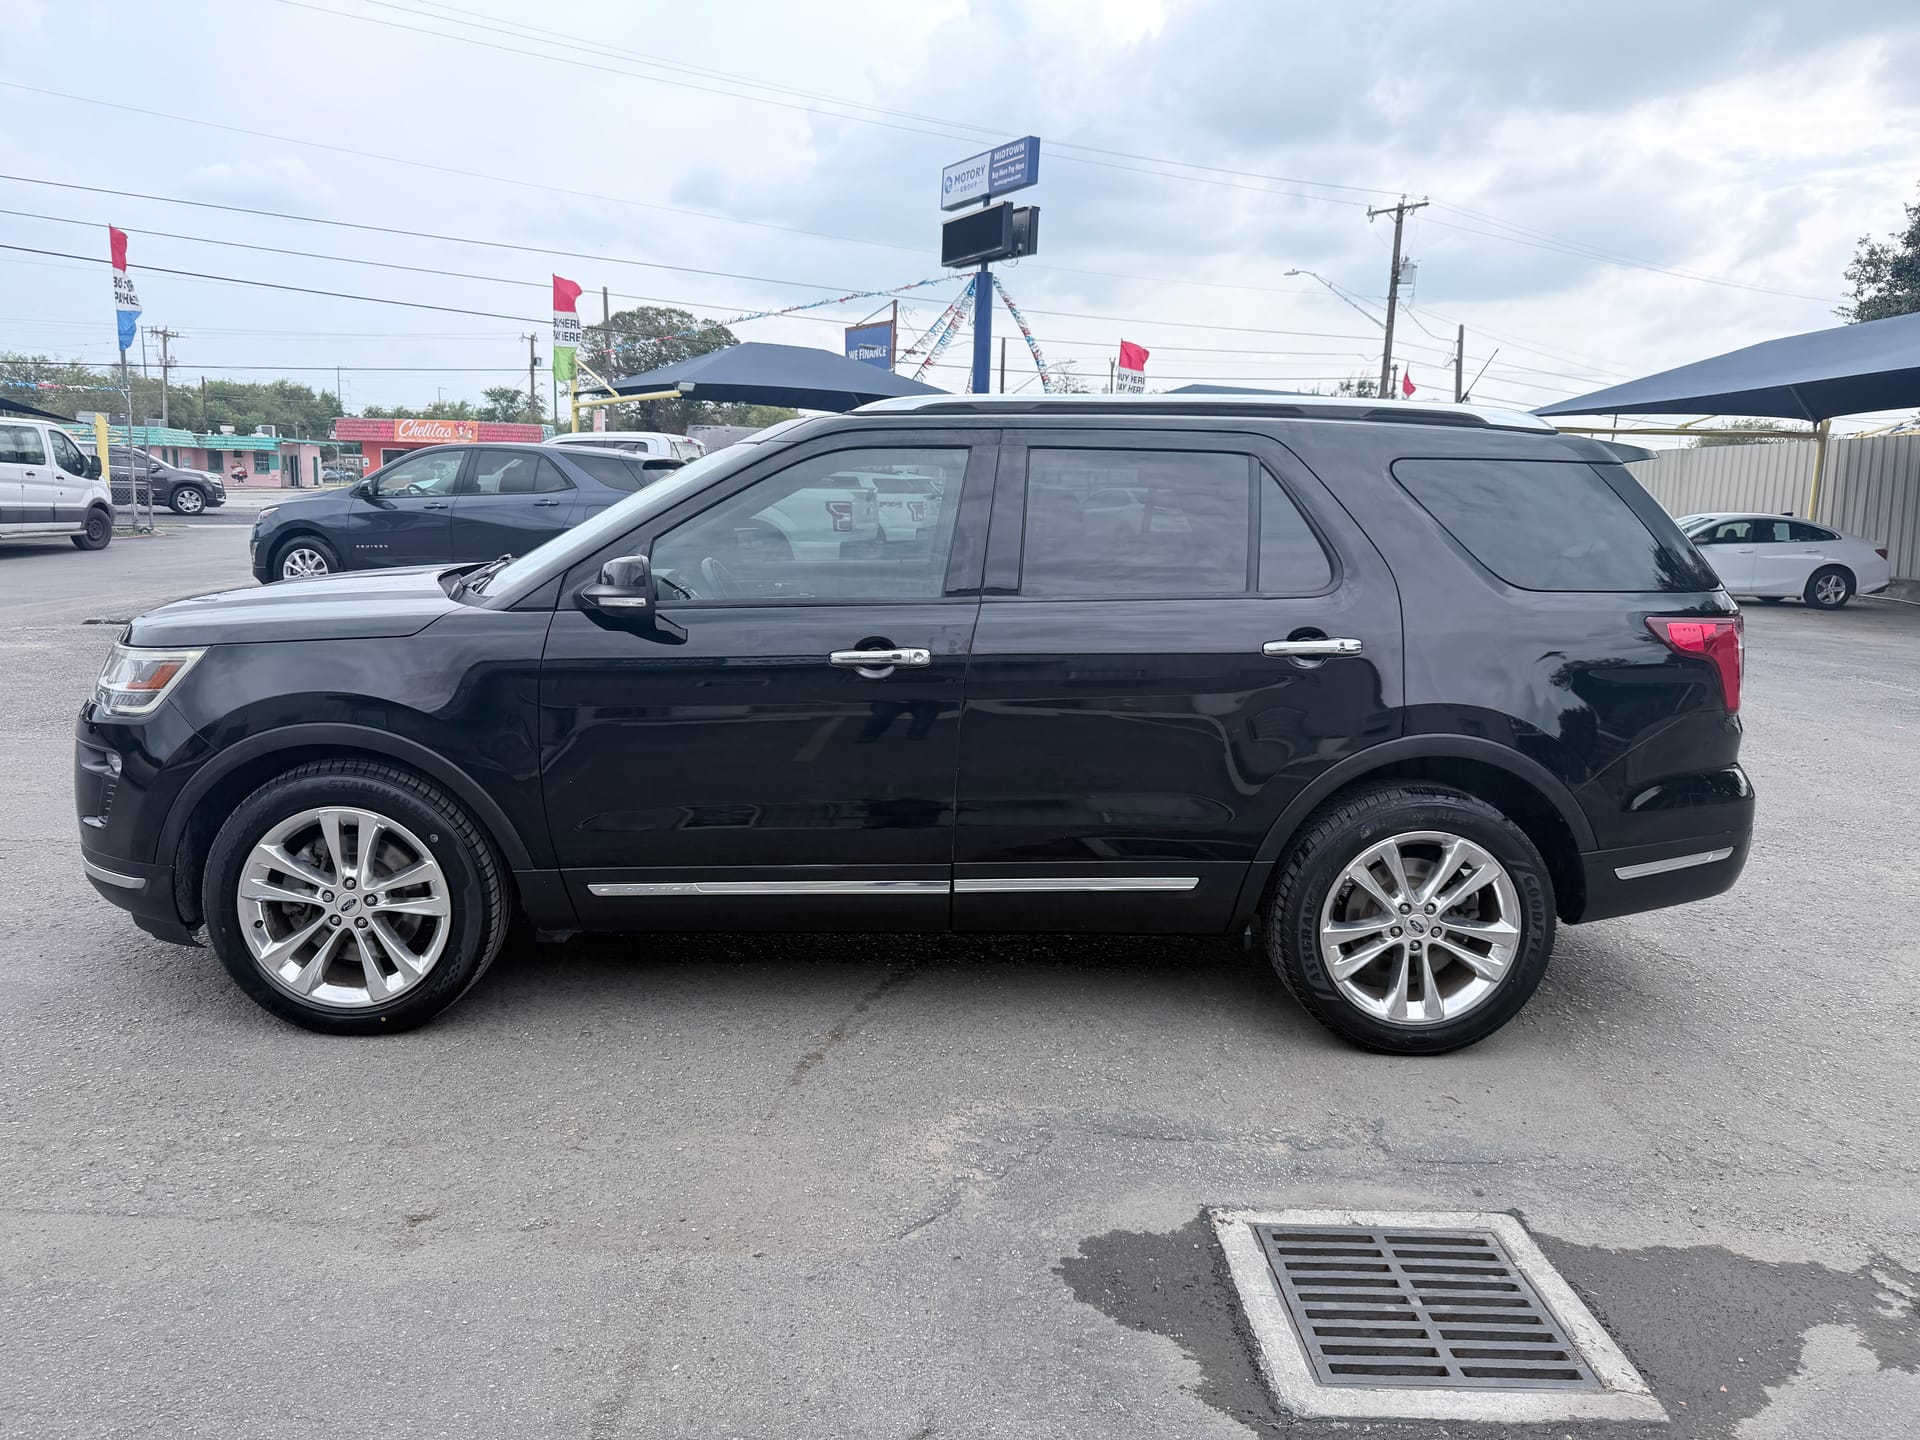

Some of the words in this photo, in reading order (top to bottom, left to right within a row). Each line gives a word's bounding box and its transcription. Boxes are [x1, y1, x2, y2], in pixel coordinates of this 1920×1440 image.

[994, 143, 1025, 161] MIDTOWN
[954, 165, 986, 186] MOTORY
[960, 181, 978, 193] GROUP
[848, 350, 858, 360] WE
[859, 346, 887, 360] FINANCE
[398, 418, 452, 438] Chelitas
